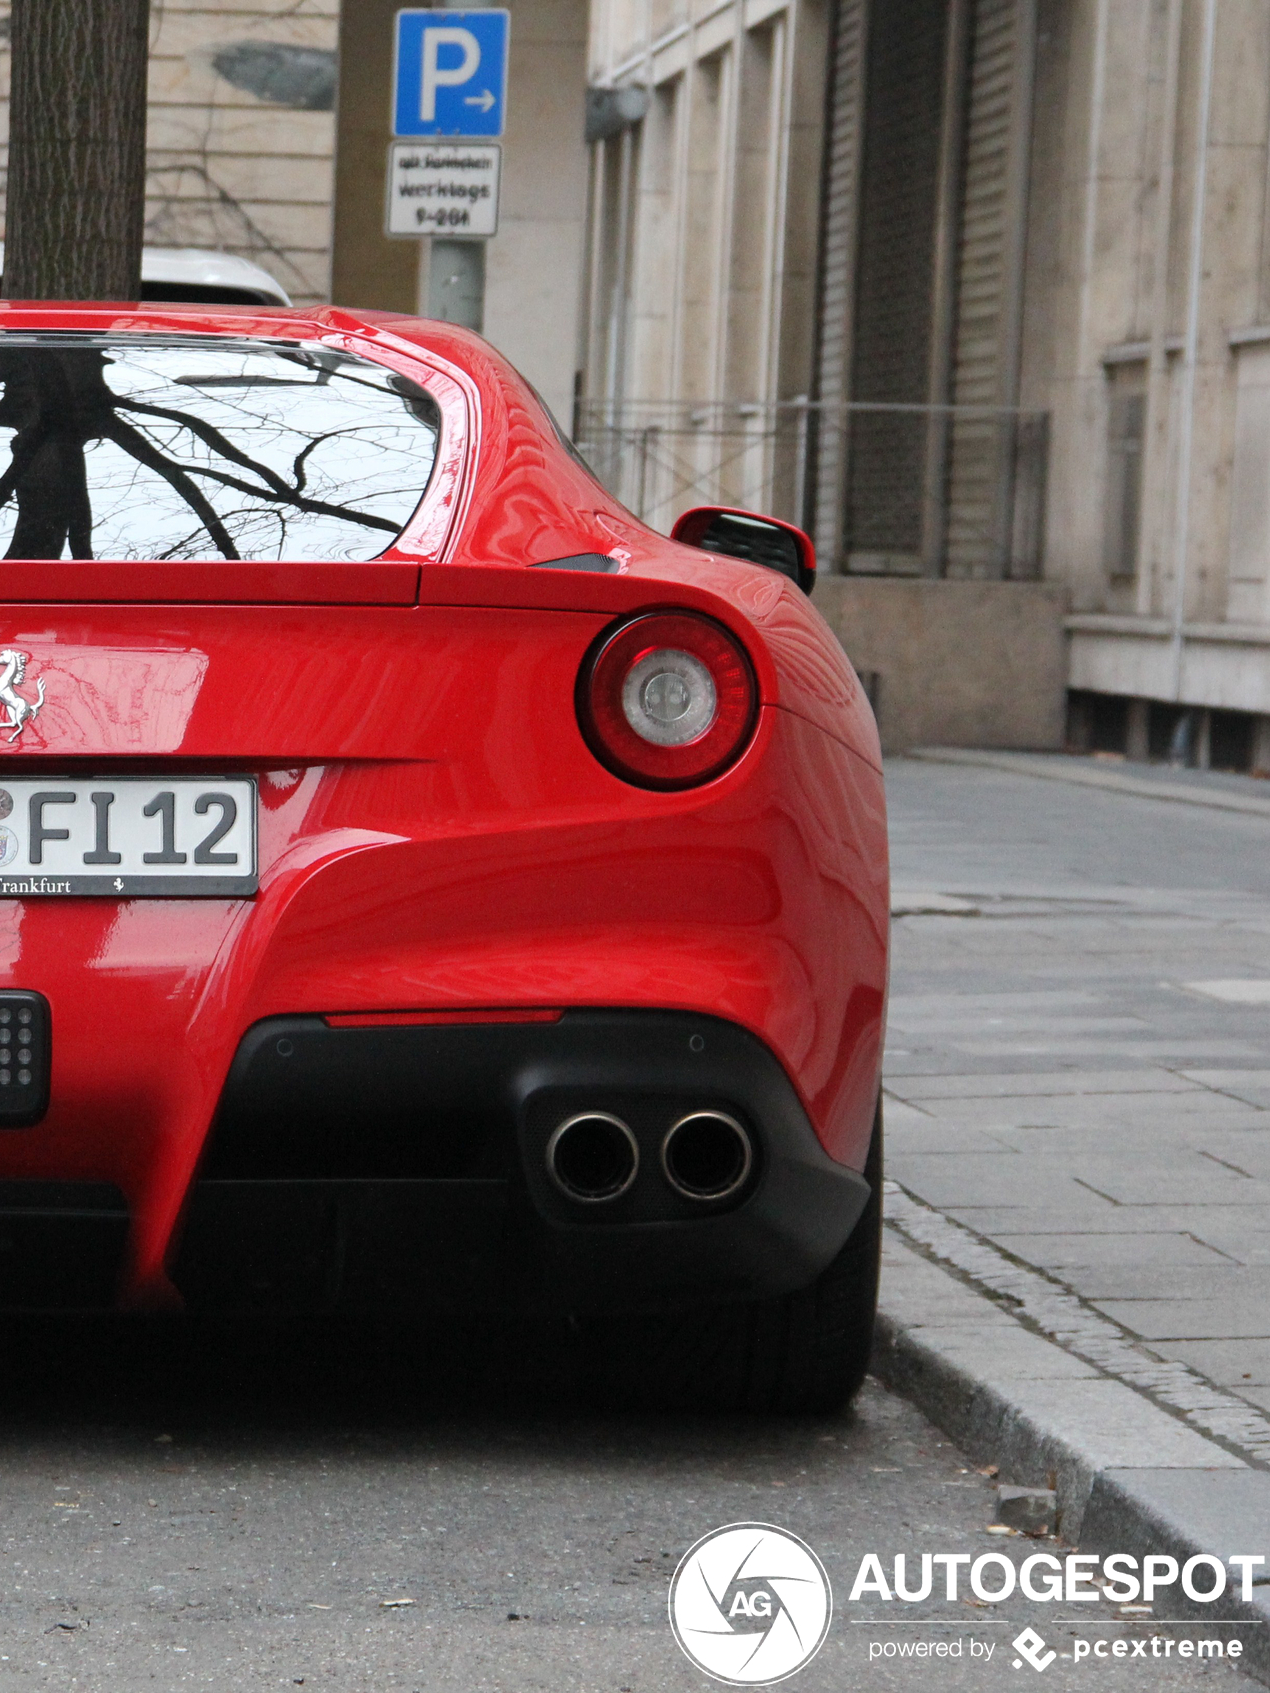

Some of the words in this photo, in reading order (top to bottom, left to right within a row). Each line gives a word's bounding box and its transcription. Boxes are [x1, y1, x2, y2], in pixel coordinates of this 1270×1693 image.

[420, 27, 481, 122] P
[28, 791, 122, 865] FI
[143, 791, 238, 865] 12
